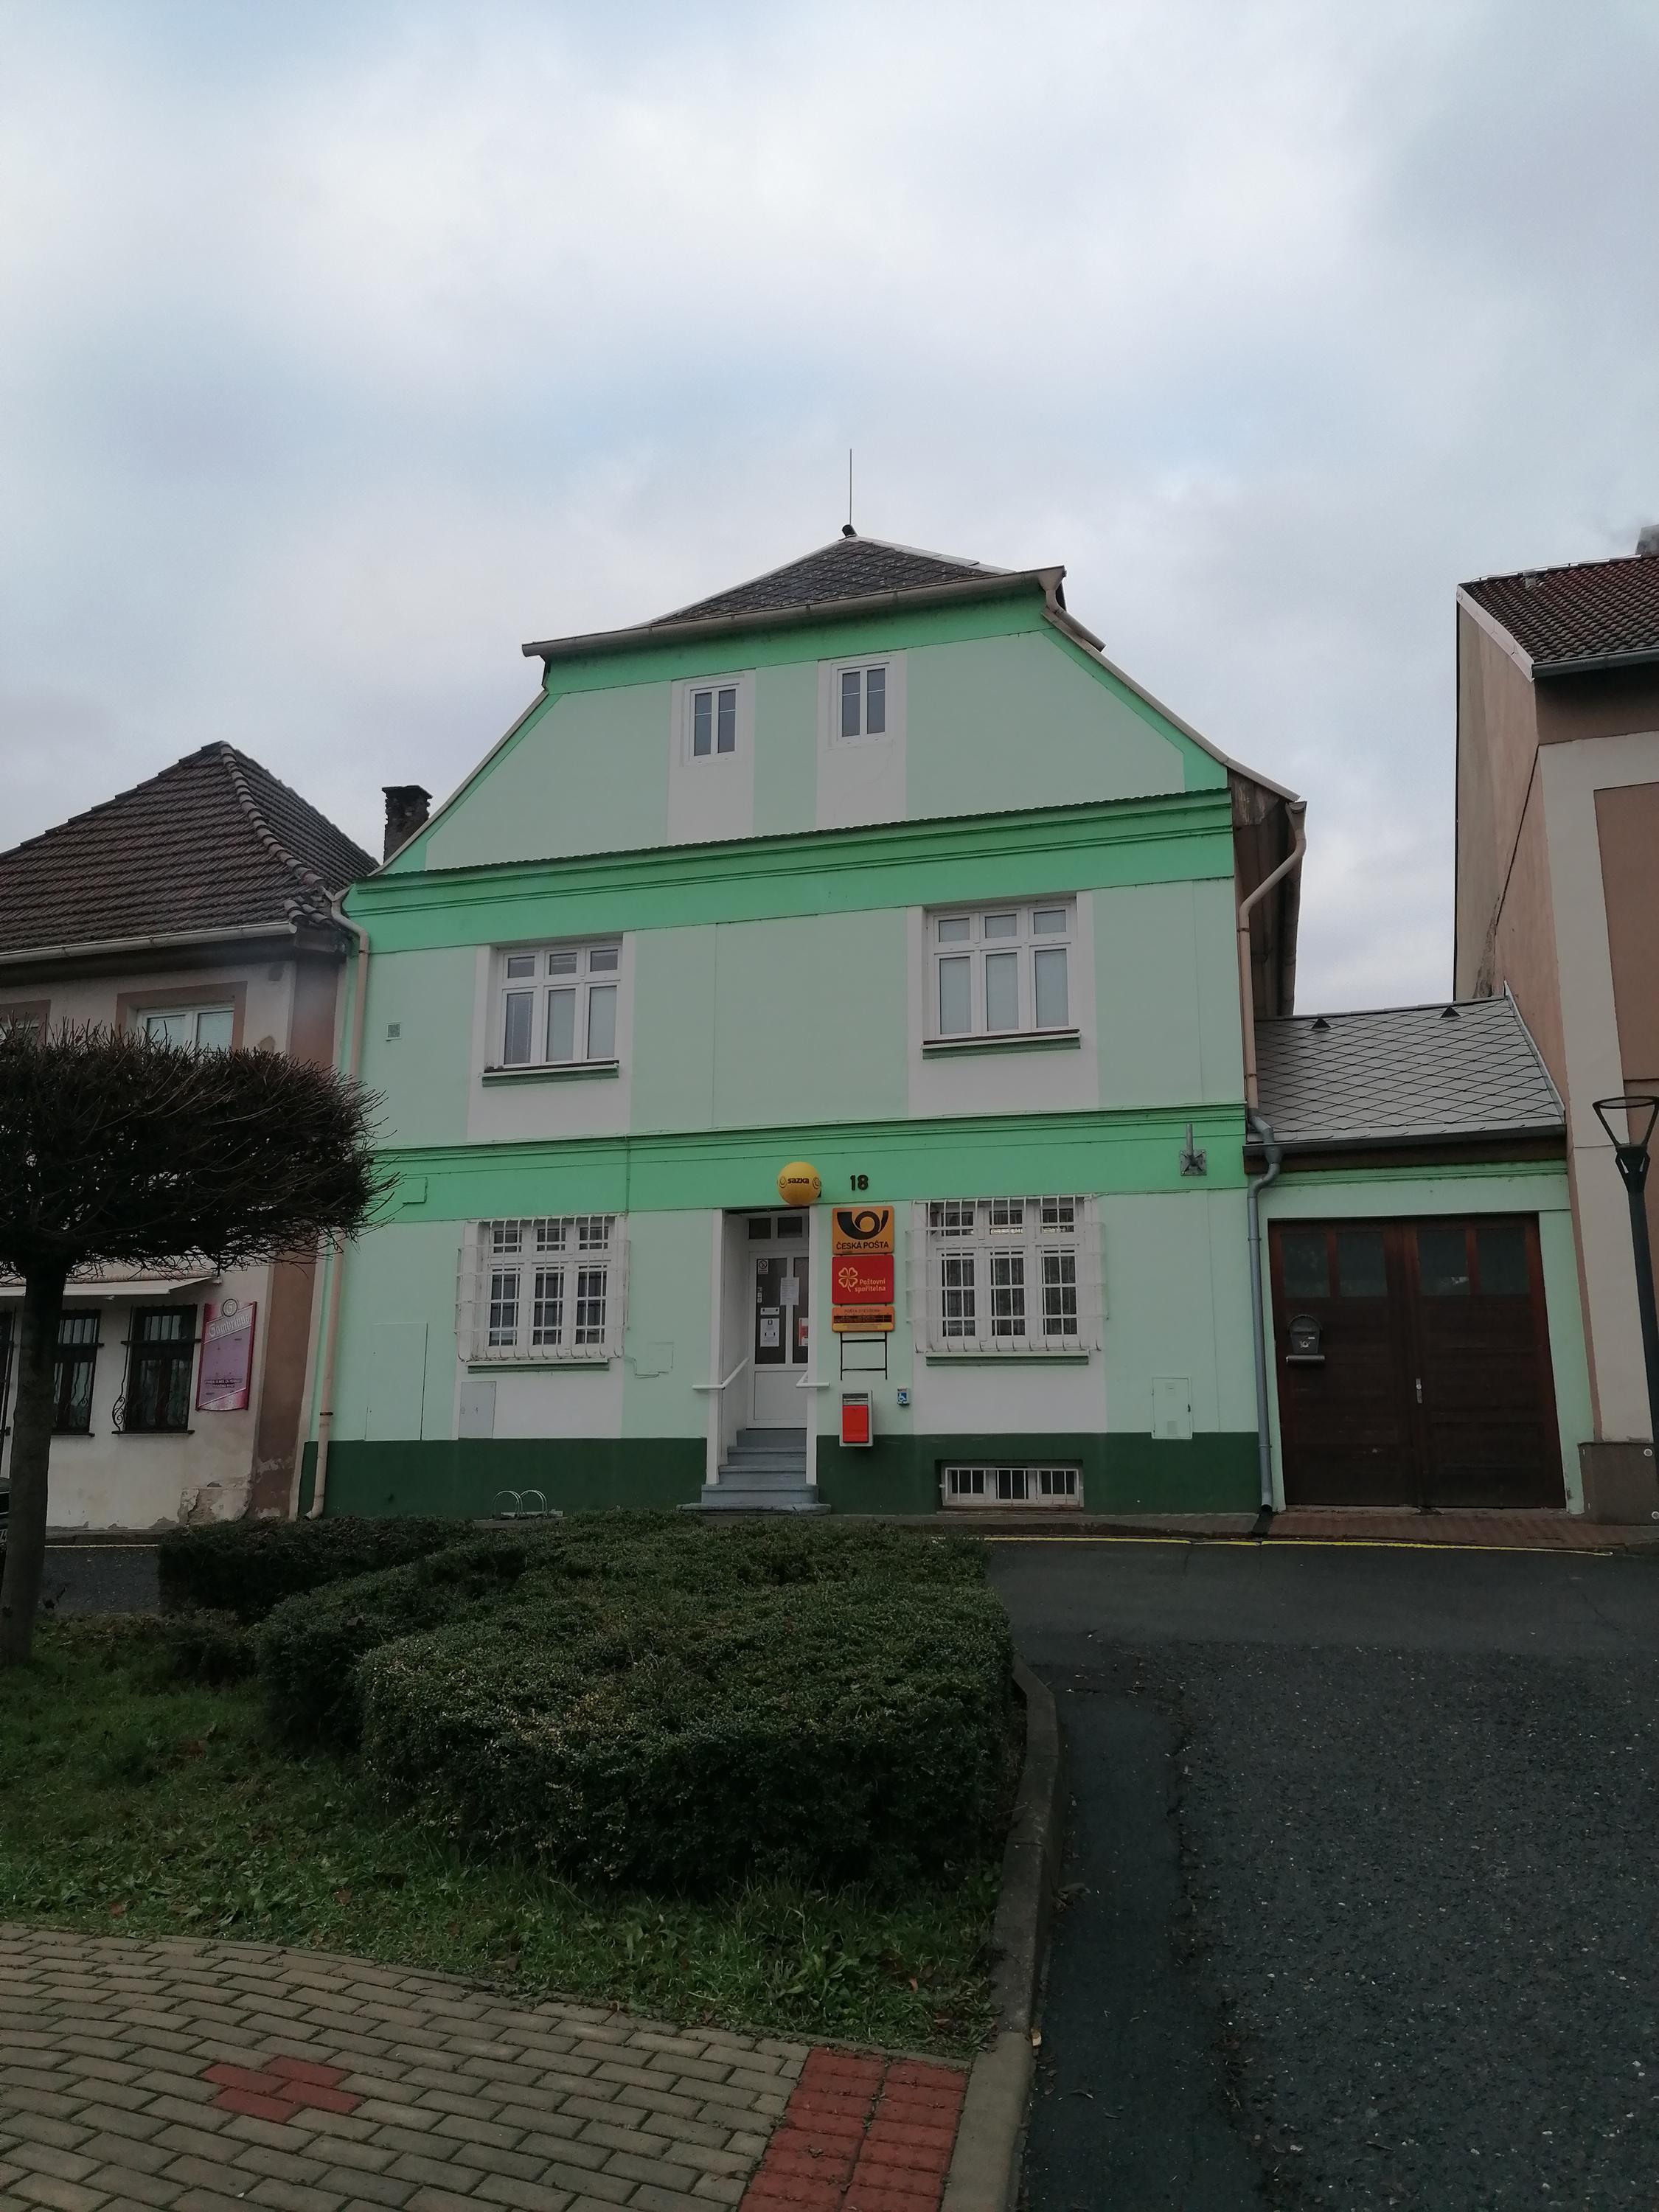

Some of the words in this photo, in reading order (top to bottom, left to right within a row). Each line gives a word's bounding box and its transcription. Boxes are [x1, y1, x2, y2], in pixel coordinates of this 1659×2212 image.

[849, 1175, 869, 1191] 18
[836, 1241, 862, 1250] ČESKÁ
[863, 1240, 889, 1249] POŠTA
[855, 1285, 886, 1293] spořitelna
[209, 1315, 249, 1337] Gambrinus
